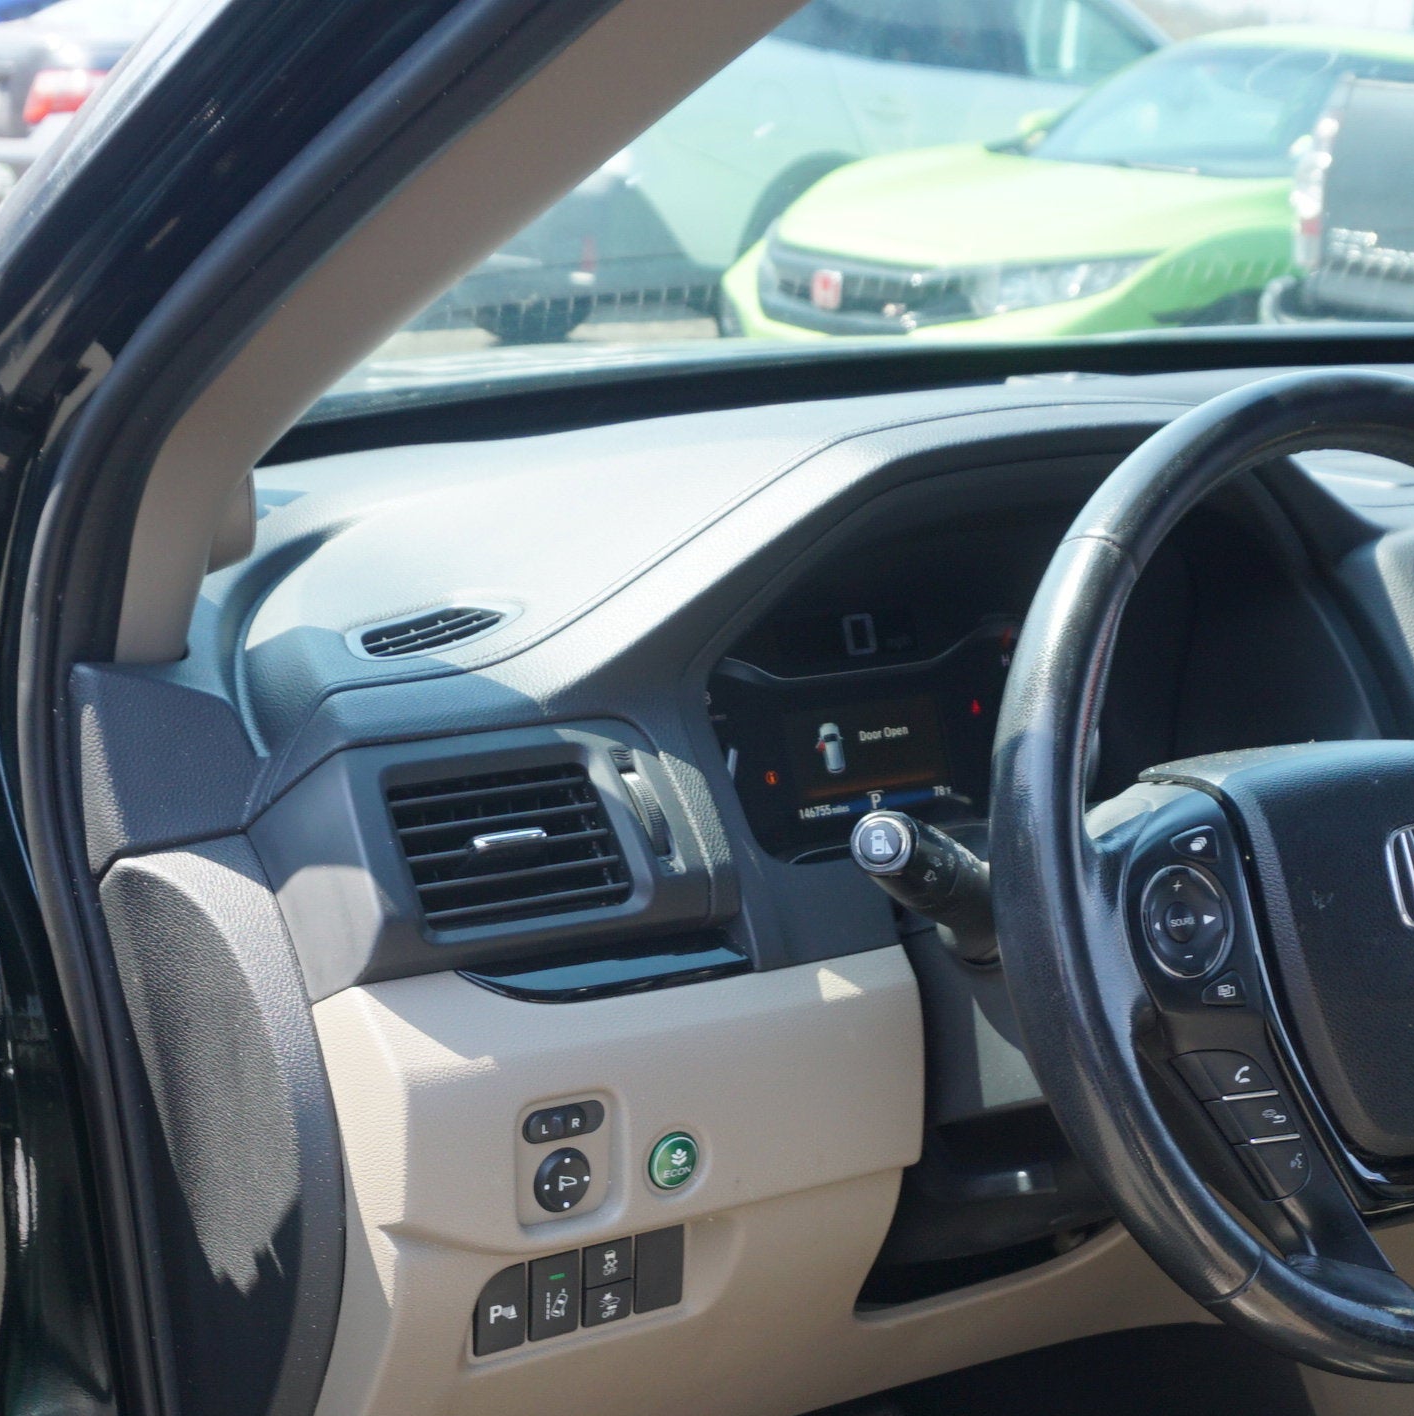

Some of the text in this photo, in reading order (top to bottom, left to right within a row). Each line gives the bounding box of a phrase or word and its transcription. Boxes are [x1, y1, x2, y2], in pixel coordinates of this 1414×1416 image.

[859, 726, 909, 742] Door Open
[870, 793, 882, 810] P
[798, 805, 832, 819] 146755
[541, 1118, 580, 1134] L R
[663, 1165, 692, 1178] ECON
[489, 1304, 502, 1324] P
[601, 1309, 617, 1318] OFF
